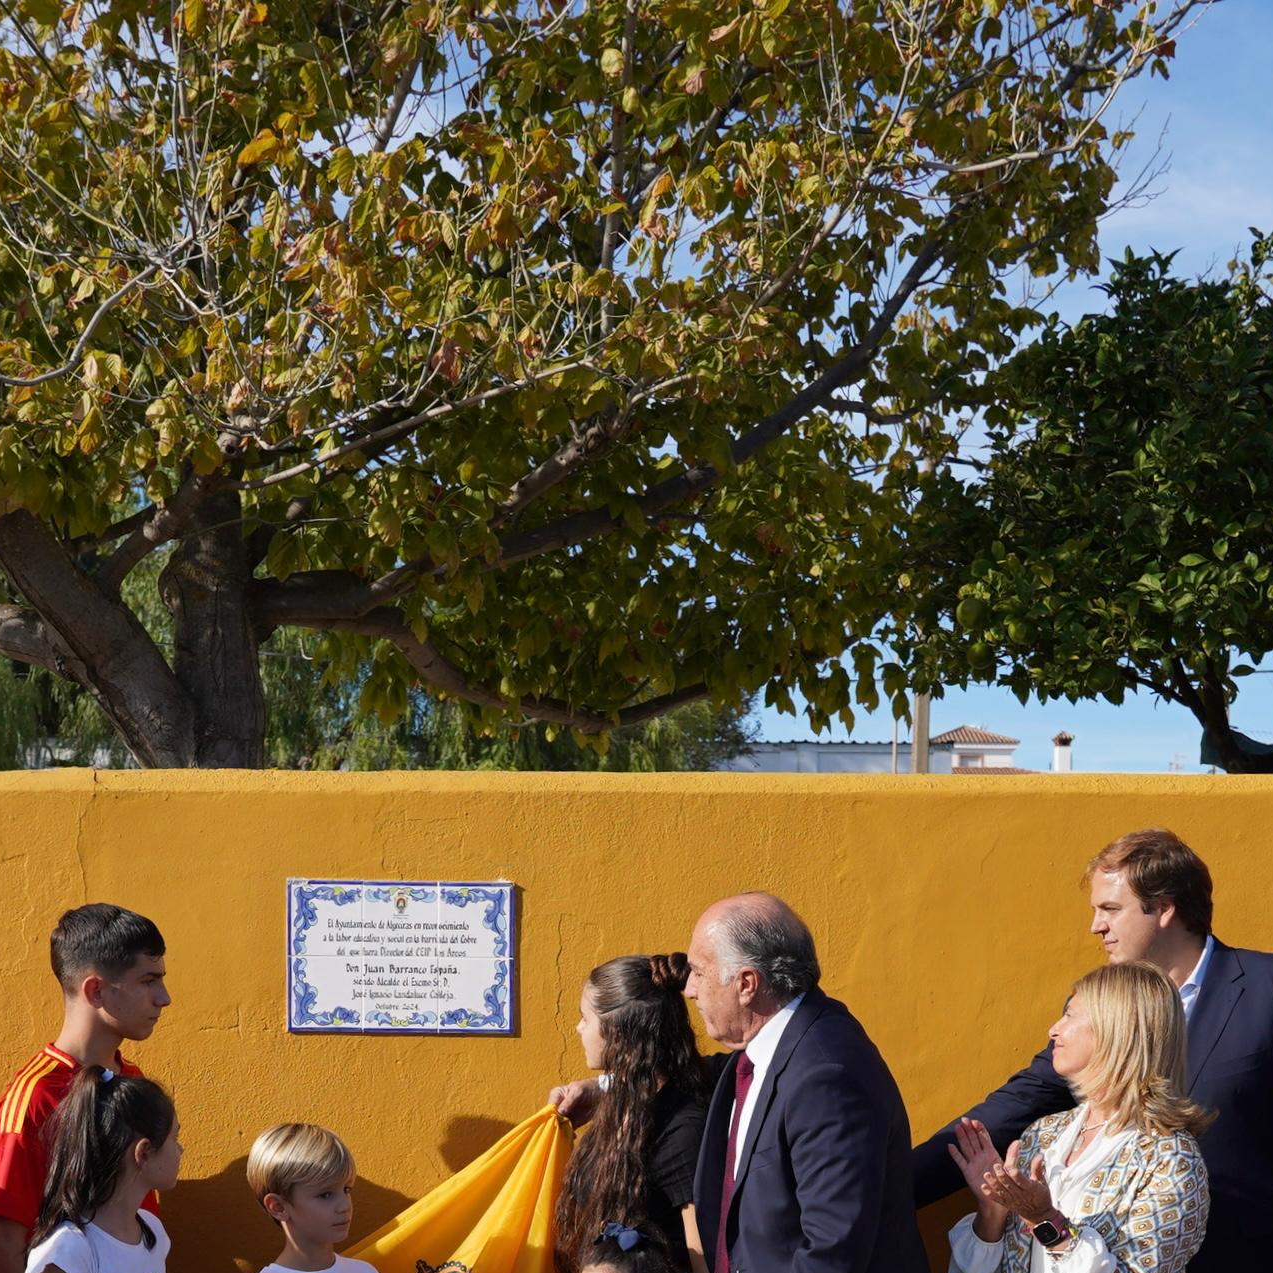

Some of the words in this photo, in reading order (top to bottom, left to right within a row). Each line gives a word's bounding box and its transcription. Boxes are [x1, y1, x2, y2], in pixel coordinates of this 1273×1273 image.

[327, 918, 334, 928] El
[335, 919, 376, 931] Ayuntamiento
[378, 920, 384, 929] de
[414, 922, 422, 930] en
[328, 933, 334, 942] la
[336, 933, 352, 942] labor
[353, 933, 380, 943] educativa
[387, 934, 405, 943] social
[450, 935, 459, 944] del
[460, 934, 478, 944] Cobre
[337, 947, 345, 956] del
[349, 949, 360, 957] que
[380, 946, 404, 957] Director
[404, 947, 414, 957] del
[446, 948, 467, 957] Arcos
[346, 963, 360, 973] Don
[362, 964, 385, 976] Juan
[389, 964, 427, 974] Barranco
[352, 977, 375, 986] siendo
[376, 977, 400, 986] Alcalde
[402, 977, 409, 987] el
[351, 989, 367, 1000] José
[369, 989, 393, 999] Ignacio
[394, 990, 428, 999] Landaluce
